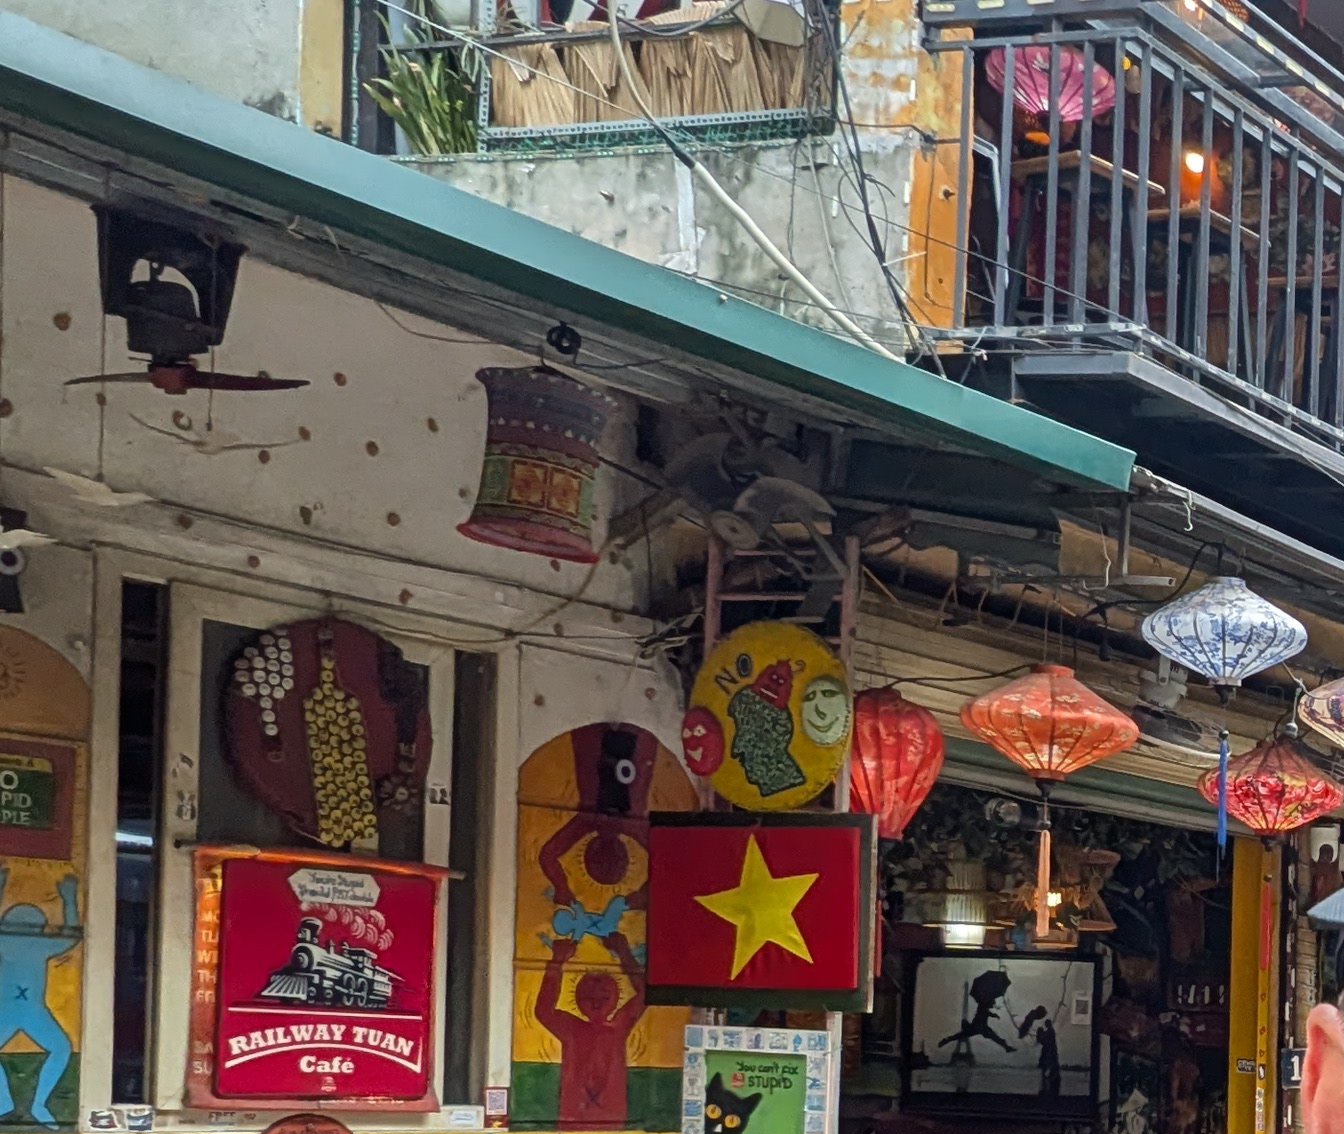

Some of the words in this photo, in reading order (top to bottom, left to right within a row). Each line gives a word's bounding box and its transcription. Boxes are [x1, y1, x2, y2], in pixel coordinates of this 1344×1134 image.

[714, 653, 752, 695] NO
[228, 1024, 347, 1055] RAILWAY
[352, 1026, 414, 1057] TUAN
[299, 1055, 355, 1074] Café
